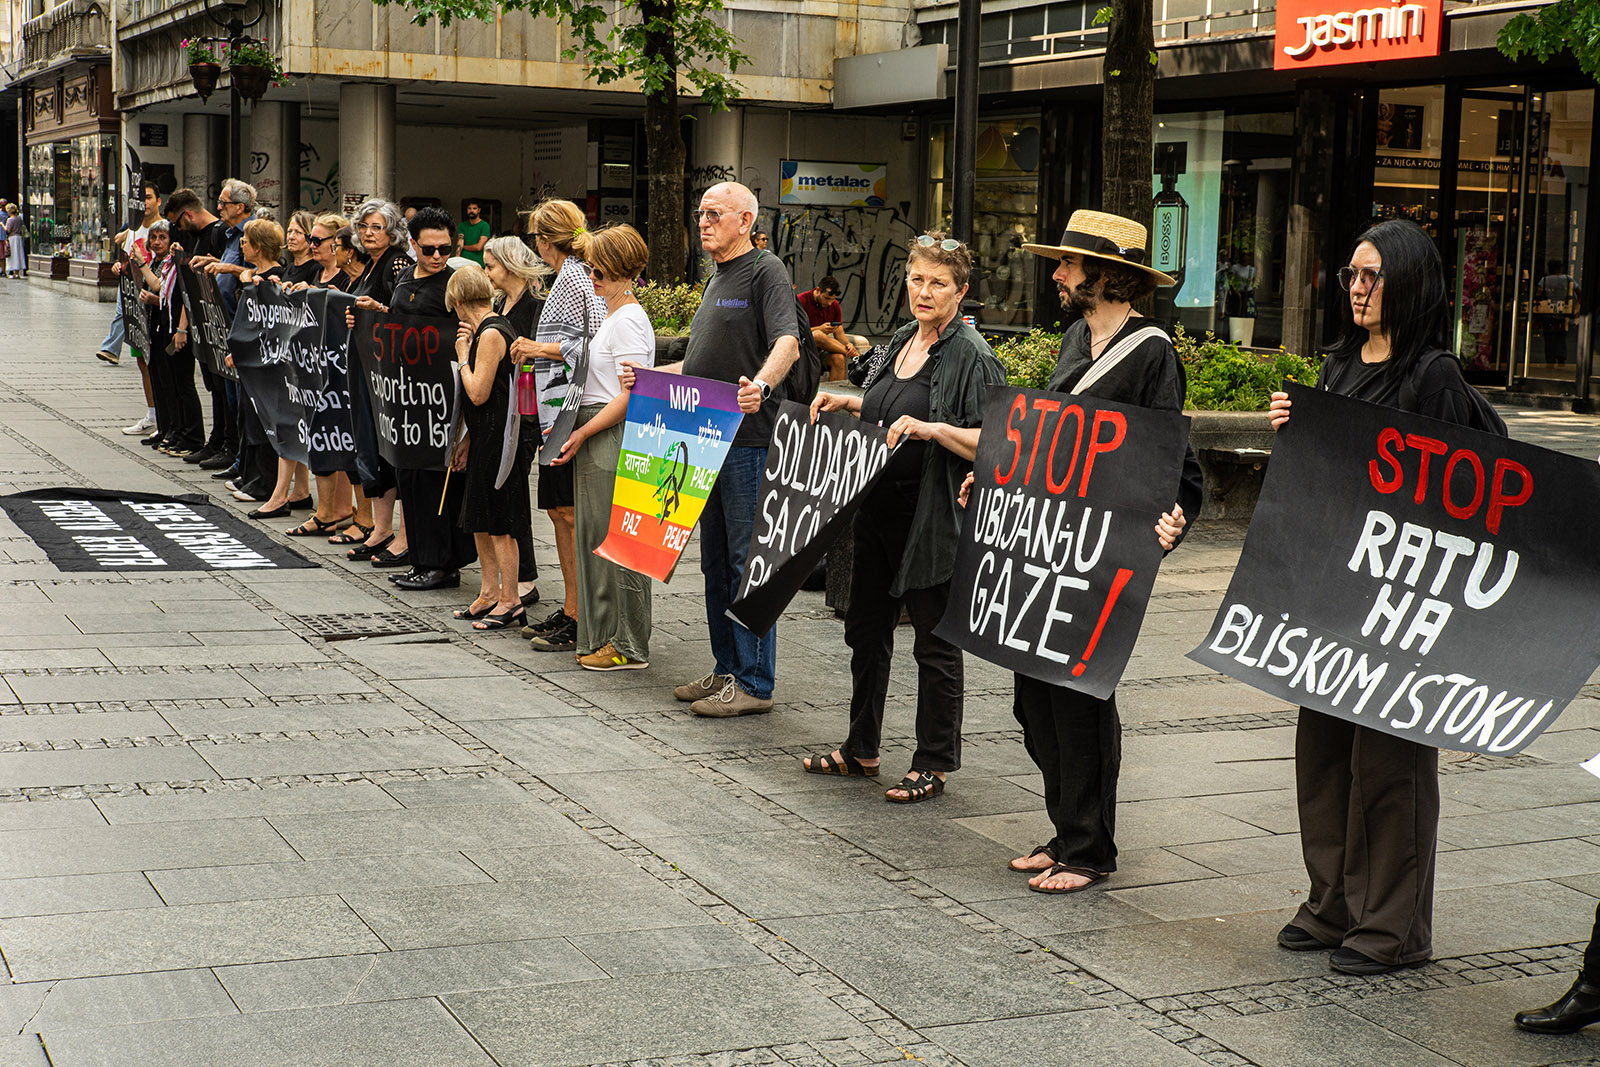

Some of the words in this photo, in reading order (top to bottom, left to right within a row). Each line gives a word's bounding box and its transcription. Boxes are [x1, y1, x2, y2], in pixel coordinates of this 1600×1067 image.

[1284, 0, 1426, 56] Jasmin
[798, 175, 871, 188] metalac
[1382, 158, 1392, 166] ZA
[1394, 159, 1416, 167] NJEGA
[1481, 163, 1495, 171] FOR
[1496, 164, 1510, 172] HIM
[604, 205, 630, 215] SBG
[1160, 211, 1172, 265] BOSS
[246, 298, 268, 328] Stop
[372, 322, 440, 366] STOP
[669, 384, 700, 413] МИР
[401, 410, 421, 446] to
[428, 409, 451, 448] Isr
[995, 393, 1128, 497] STOP
[1369, 427, 1533, 534] STOP
[31, 500, 124, 531] PROTIV
[621, 511, 642, 536] PAZ
[758, 489, 789, 552] SA
[71, 535, 168, 566] RATA
[662, 525, 690, 551] PEACE
[1348, 510, 1519, 609] RATU
[1361, 583, 1453, 655] NA
